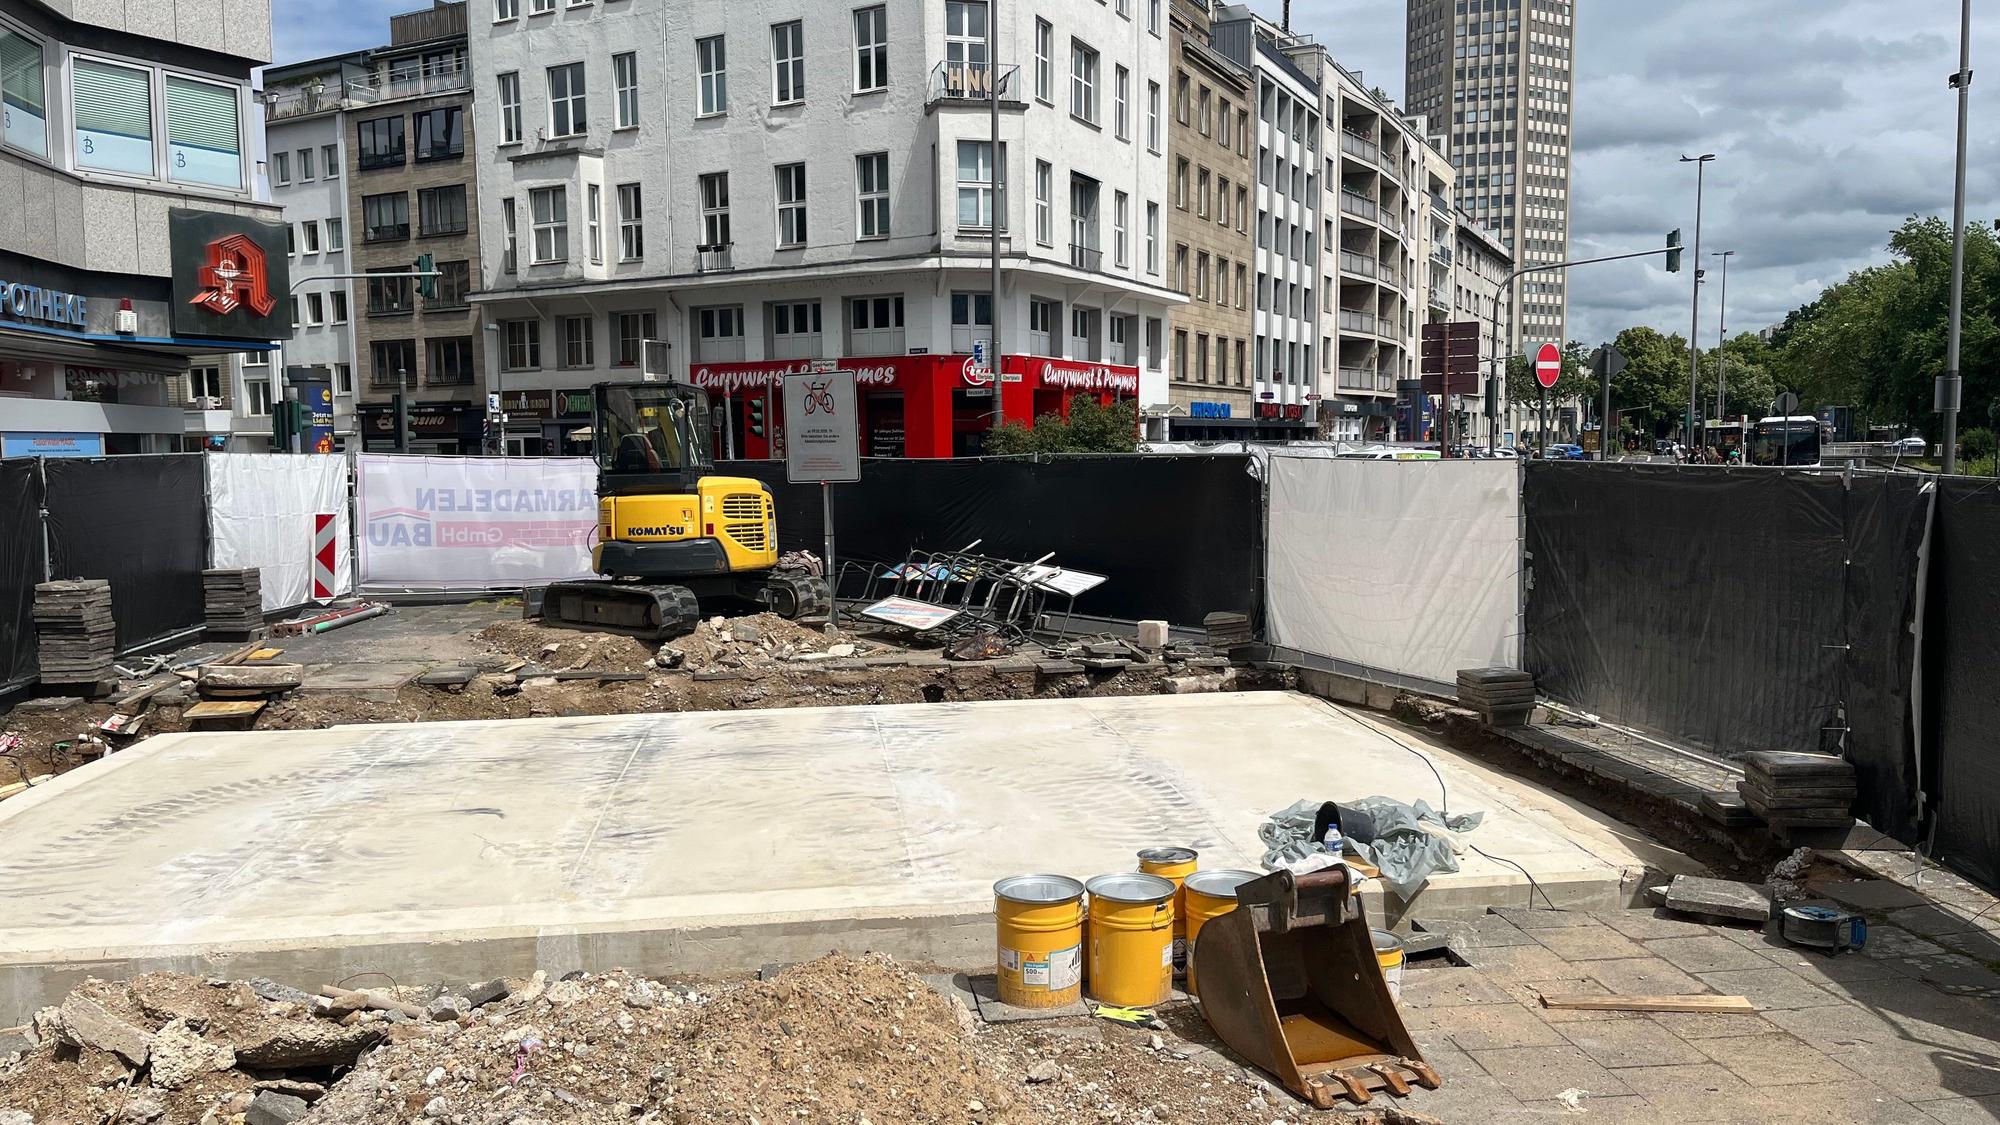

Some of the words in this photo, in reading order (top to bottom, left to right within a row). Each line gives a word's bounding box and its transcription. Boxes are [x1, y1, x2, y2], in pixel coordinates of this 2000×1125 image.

[0, 280, 87, 326] POTHEKE
[1044, 363, 1095, 390] Currywurst
[1104, 369, 1137, 391] Pommes
[628, 524, 685, 536] KOMATSU
